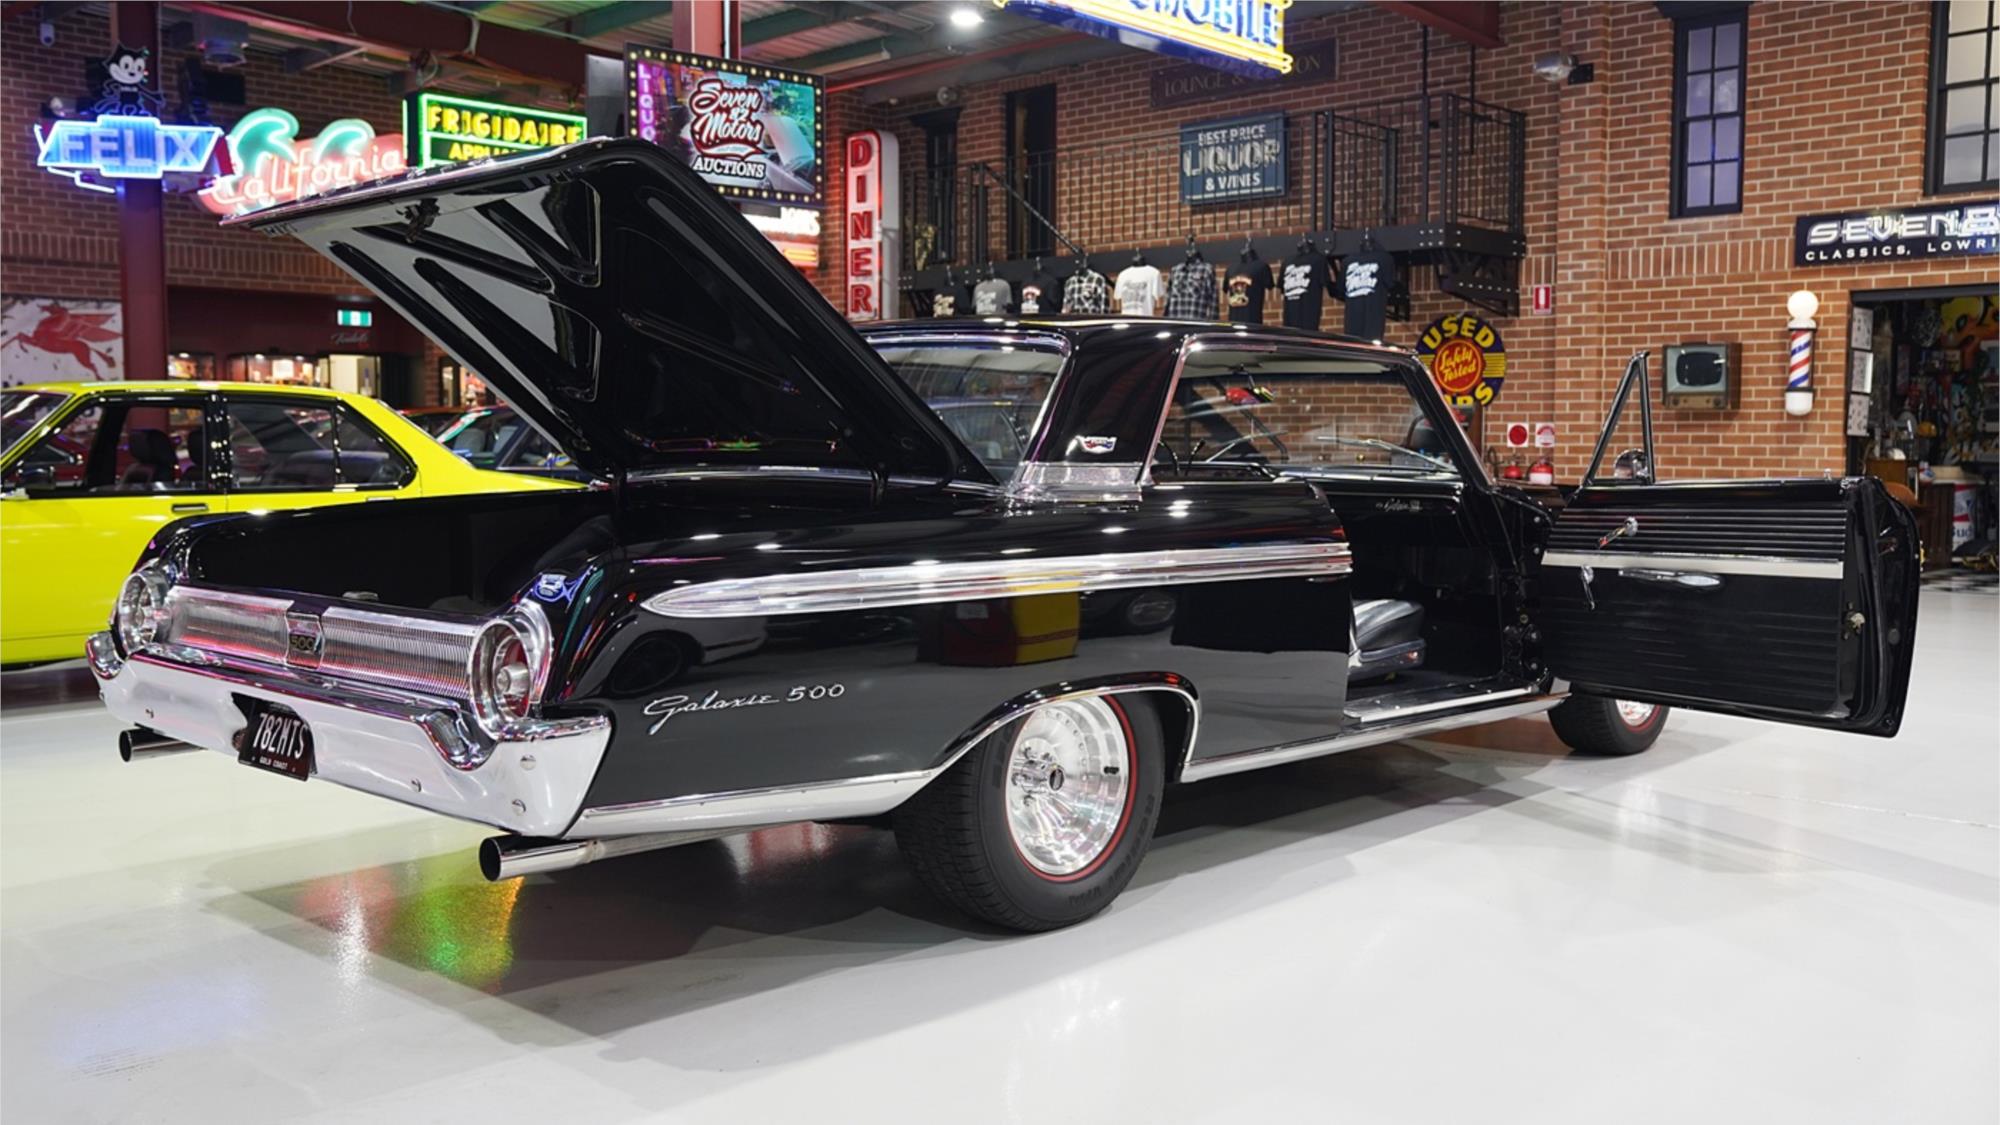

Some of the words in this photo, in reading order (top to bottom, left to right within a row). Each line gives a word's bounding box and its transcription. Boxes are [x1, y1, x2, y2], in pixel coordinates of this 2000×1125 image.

[692, 80, 760, 114] Seven
[1164, 72, 1225, 97] LOUNGE
[638, 63, 657, 143] LIQUO
[427, 104, 582, 145] FRIGIDAIRE
[693, 112, 762, 145] Motors
[1198, 129, 1228, 146] BEST
[1230, 124, 1266, 142] PRICE
[60, 128, 199, 167] FELIX
[1183, 139, 1280, 177] LIQUOR
[211, 145, 405, 204] California
[693, 157, 766, 179] AUCTIONS
[1205, 177, 1215, 191] &
[1218, 172, 1261, 190] WINES
[850, 138, 874, 314] DINER
[1423, 316, 1495, 349] USED
[1443, 359, 1476, 382] Tested
[290, 635, 314, 650] 500
[643, 690, 780, 735] Galaxie
[787, 683, 845, 702] 500
